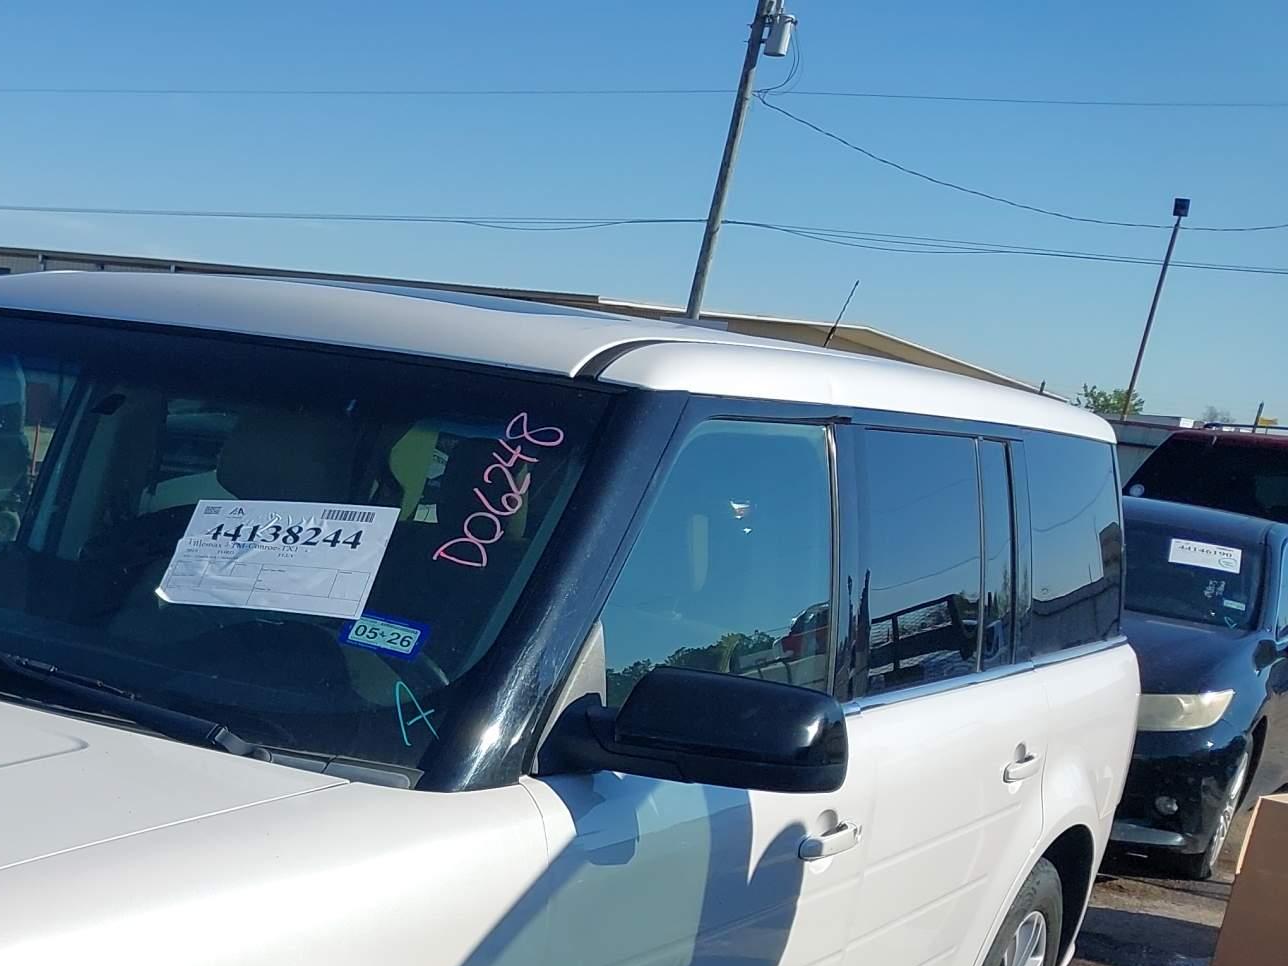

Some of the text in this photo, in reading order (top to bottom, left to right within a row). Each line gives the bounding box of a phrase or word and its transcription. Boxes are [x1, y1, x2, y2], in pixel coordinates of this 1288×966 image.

[205, 523, 364, 549] 44138244
[354, 624, 380, 640] 05
[386, 632, 414, 648] 26
[395, 680, 439, 746] A
